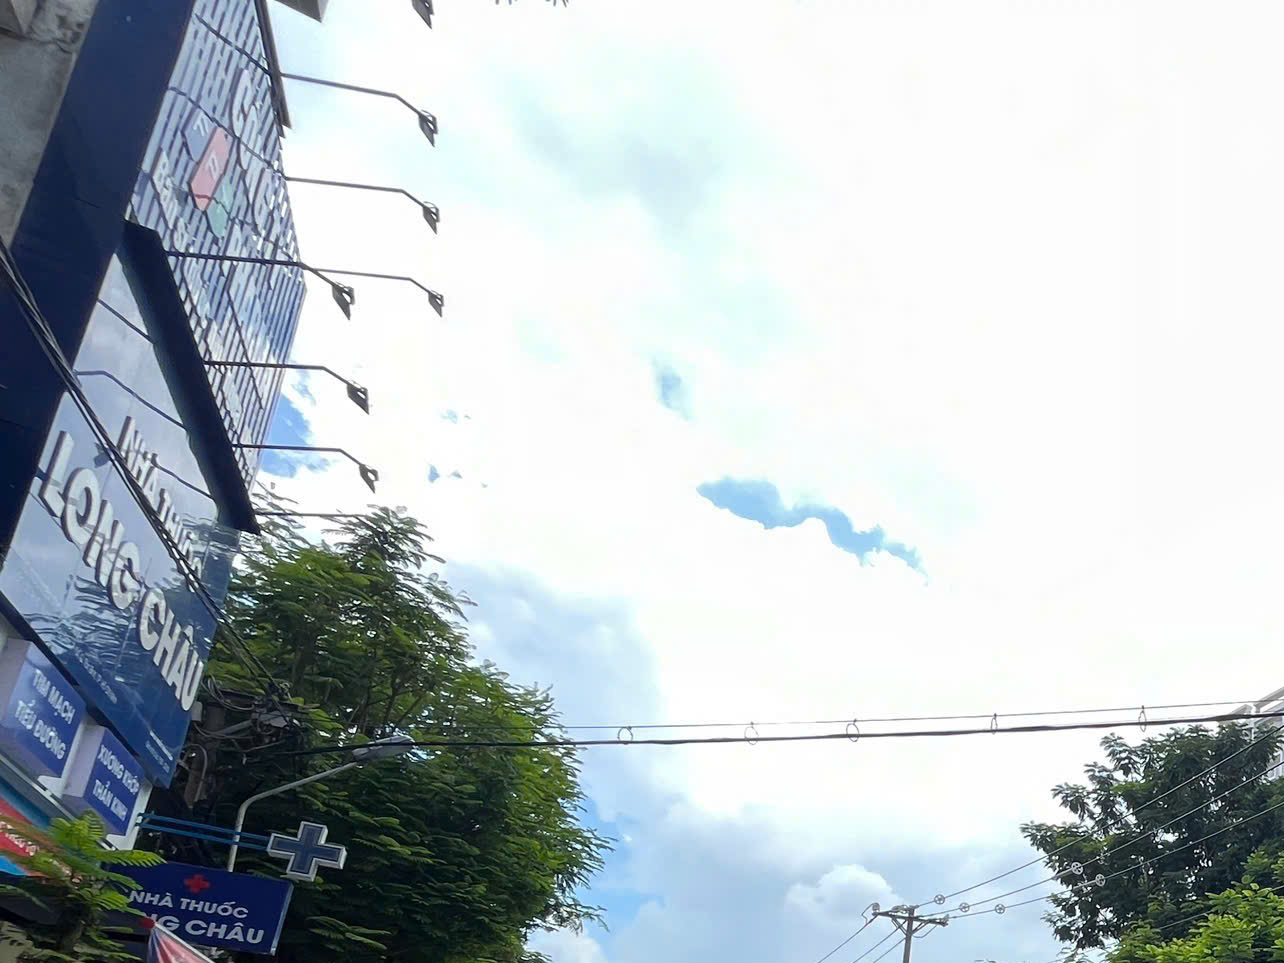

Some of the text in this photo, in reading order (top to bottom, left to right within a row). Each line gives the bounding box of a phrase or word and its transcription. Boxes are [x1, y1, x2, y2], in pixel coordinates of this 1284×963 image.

[38, 430, 141, 610] LONG
[136, 588, 204, 712] CHÂU
[48, 687, 76, 725] MẠCH
[33, 718, 66, 760] ĐƯỜNG
[98, 744, 125, 780] XƯƠNG
[130, 890, 249, 919] NHÀ THUỐC
[185, 918, 264, 944] CHÂU
